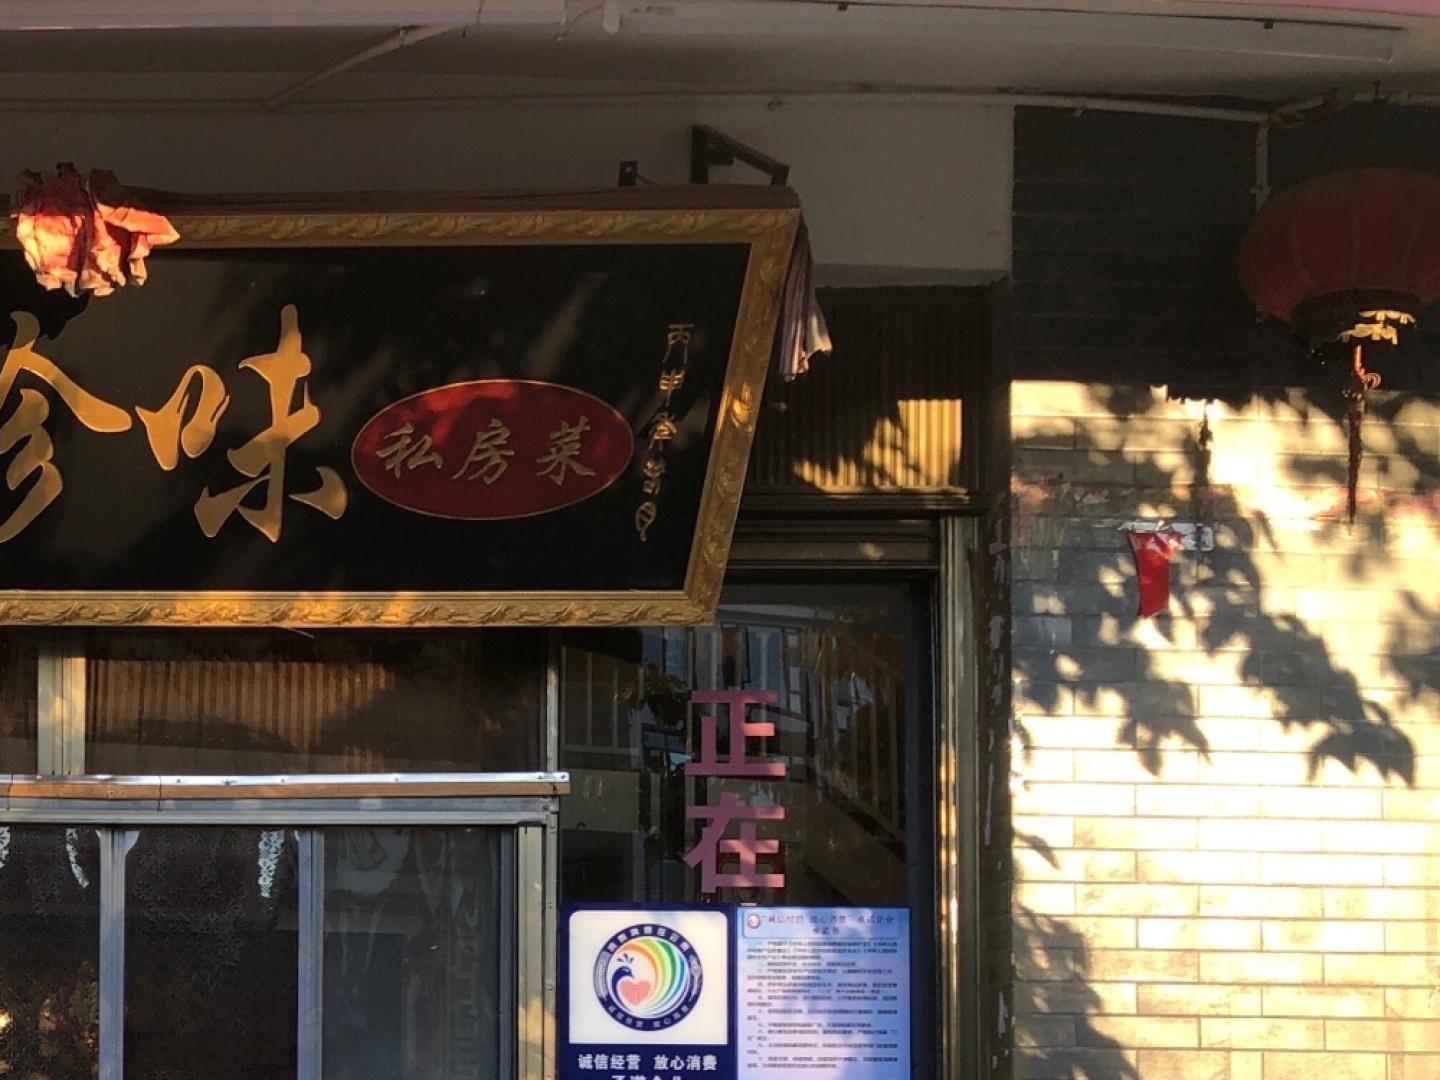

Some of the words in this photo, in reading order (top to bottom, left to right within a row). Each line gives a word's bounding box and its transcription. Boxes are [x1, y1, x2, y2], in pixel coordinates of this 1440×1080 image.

[375, 415, 597, 485] 私房菜
[683, 690, 787, 894] 正在
[578, 1054, 641, 1071] 诚信经营
[653, 1054, 717, 1071] 放心消费
